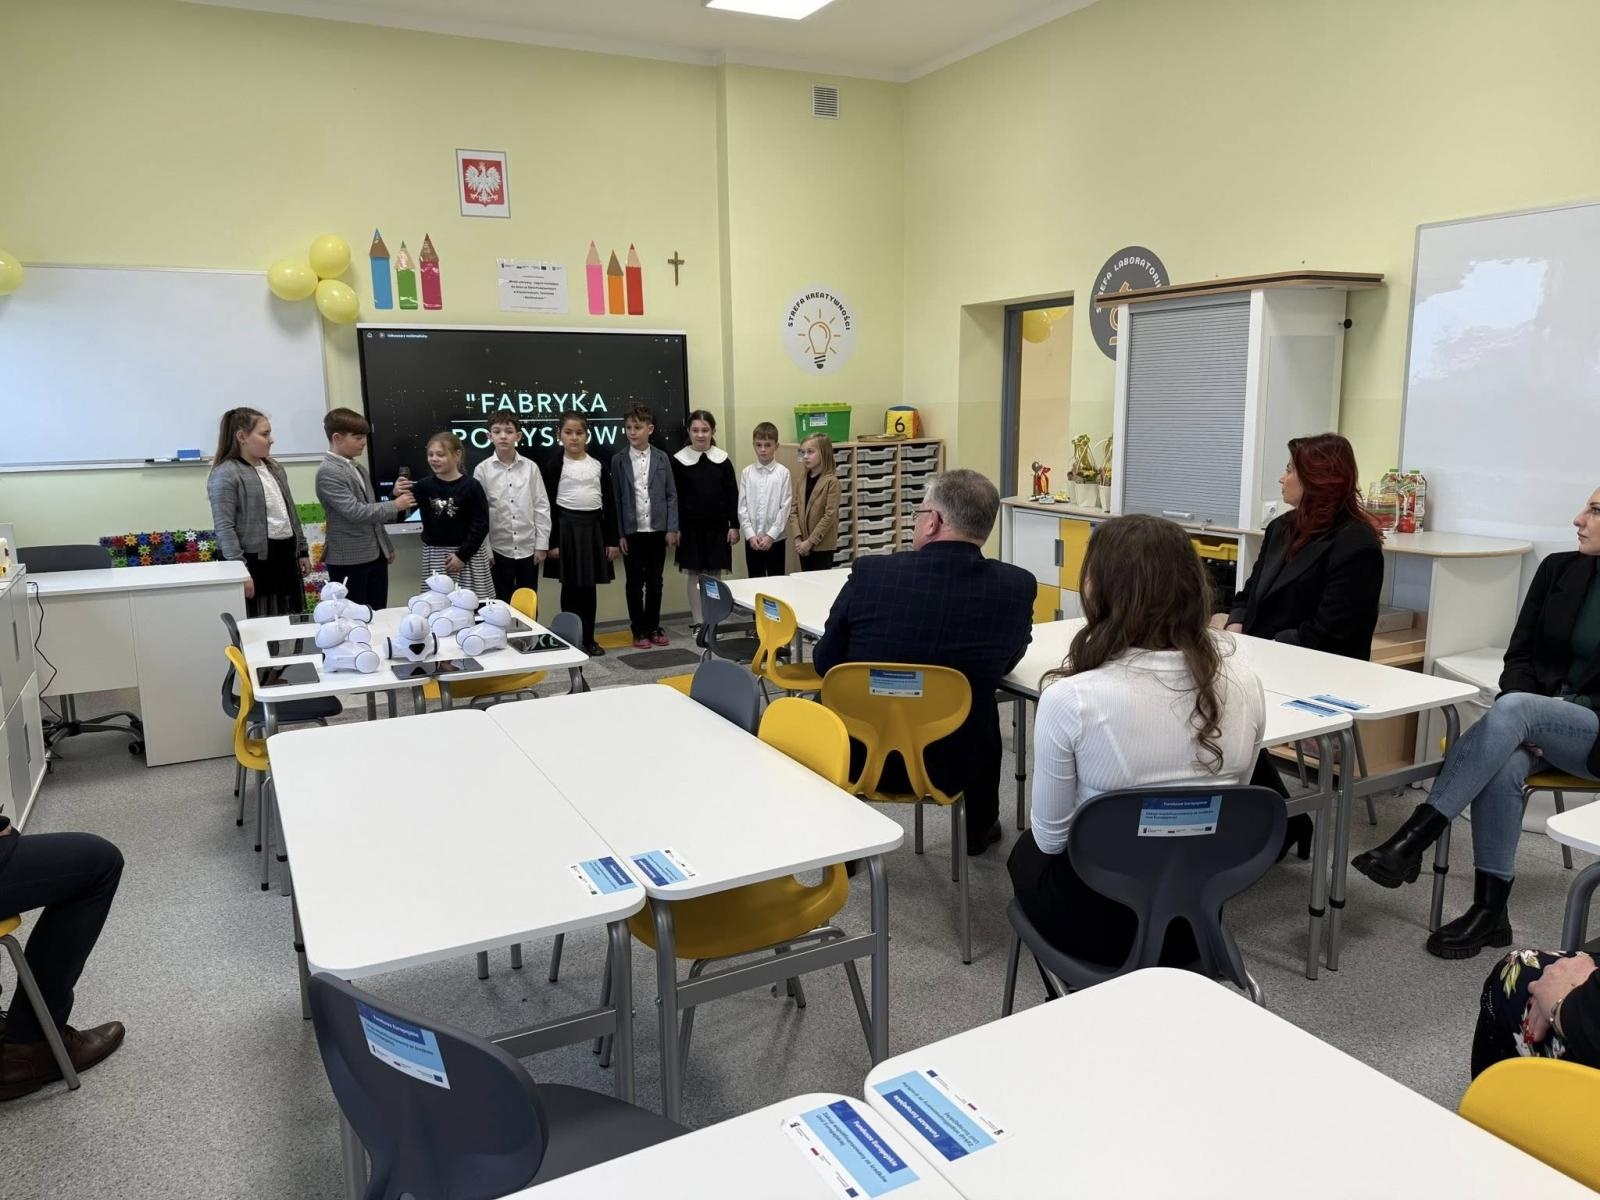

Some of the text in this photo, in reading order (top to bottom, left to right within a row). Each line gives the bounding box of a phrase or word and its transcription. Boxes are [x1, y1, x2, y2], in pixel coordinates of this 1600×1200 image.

[788, 291, 850, 330] STREFA KREATYWNOŚCI
[466, 393, 608, 413] "FABRYKA
[894, 416, 906, 433] 6
[914, 1116, 941, 1138] Fundusze
[851, 1120, 900, 1167] Fundusze Europejskie
